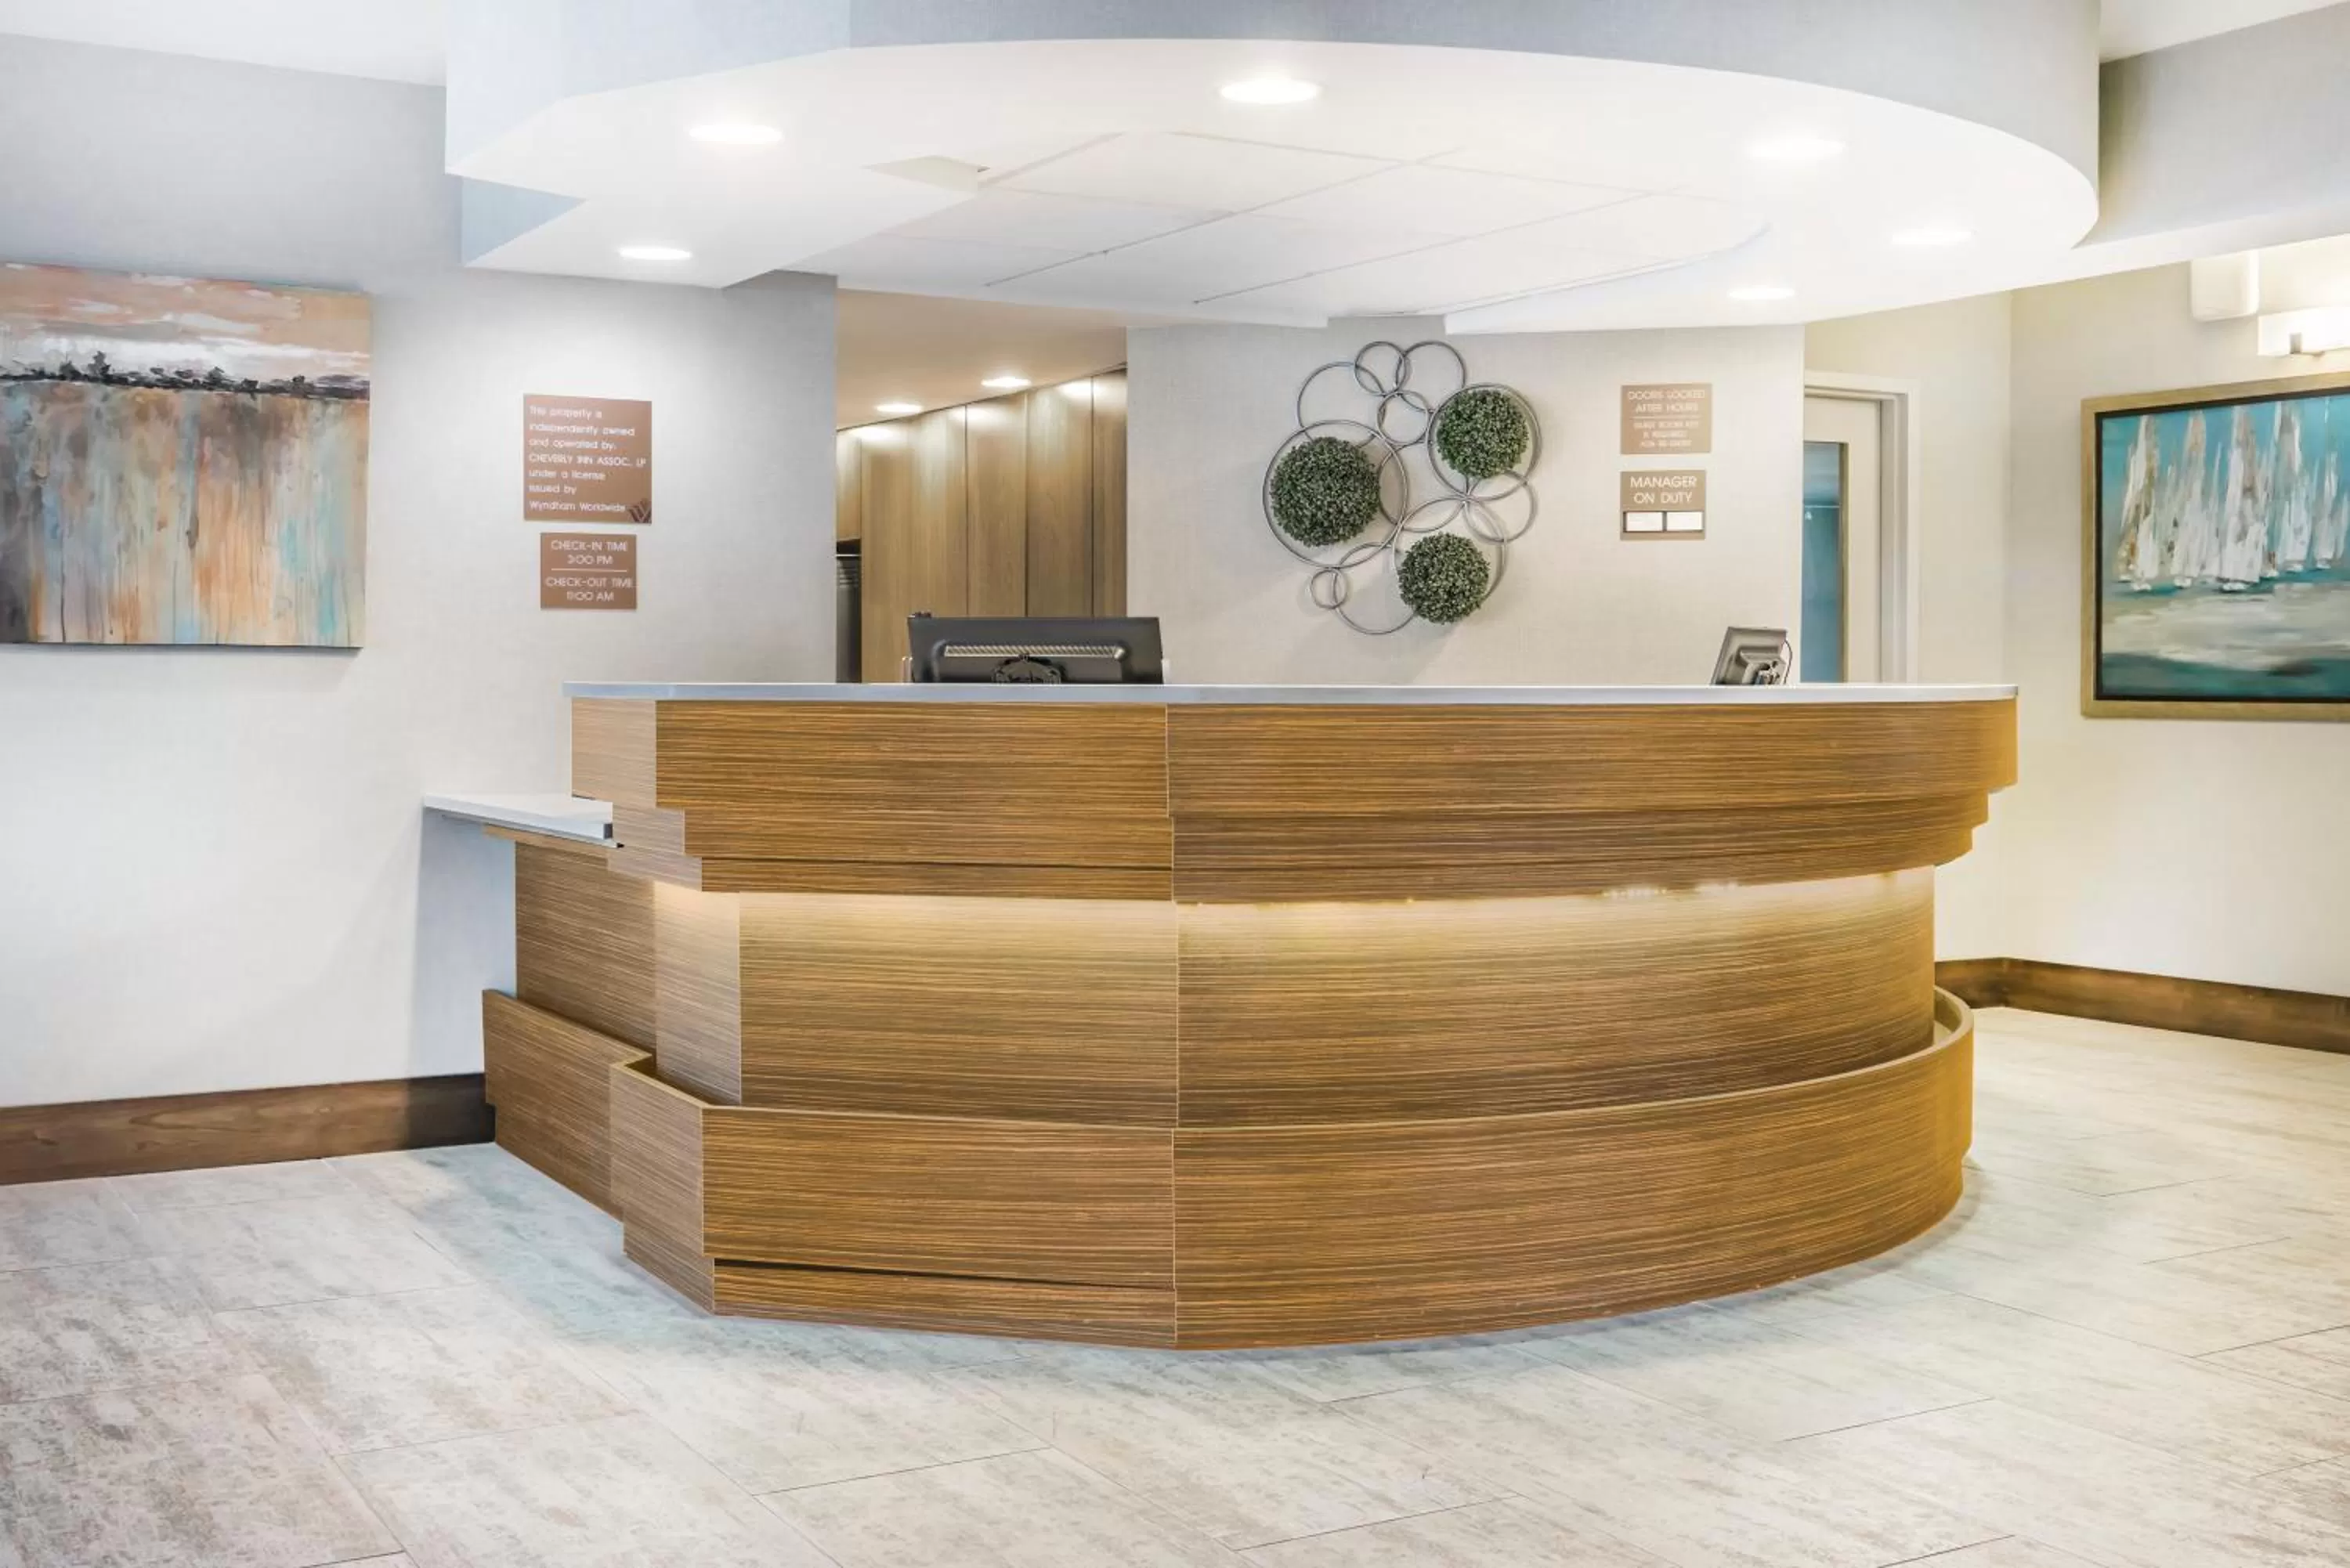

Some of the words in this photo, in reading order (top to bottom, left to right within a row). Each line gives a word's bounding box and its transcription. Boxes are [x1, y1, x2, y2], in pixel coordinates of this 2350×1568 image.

[550, 406, 591, 421] property
[529, 422, 598, 436] independently
[602, 427, 635, 436] owned
[529, 438, 549, 447] and
[529, 469, 557, 479] under
[1629, 475, 1697, 488] MANAGER
[563, 485, 577, 495] by
[1633, 492, 1655, 504] ON
[1660, 491, 1693, 504] DUTY
[529, 500, 576, 511] Wyndham
[579, 501, 626, 512] Worldwide
[551, 540, 602, 551] CHECK-IN
[607, 540, 627, 552] TIME
[597, 555, 614, 565] PM
[545, 576, 607, 587] CHECK-OUT
[612, 577, 633, 588] TIME
[596, 591, 615, 602] AM
